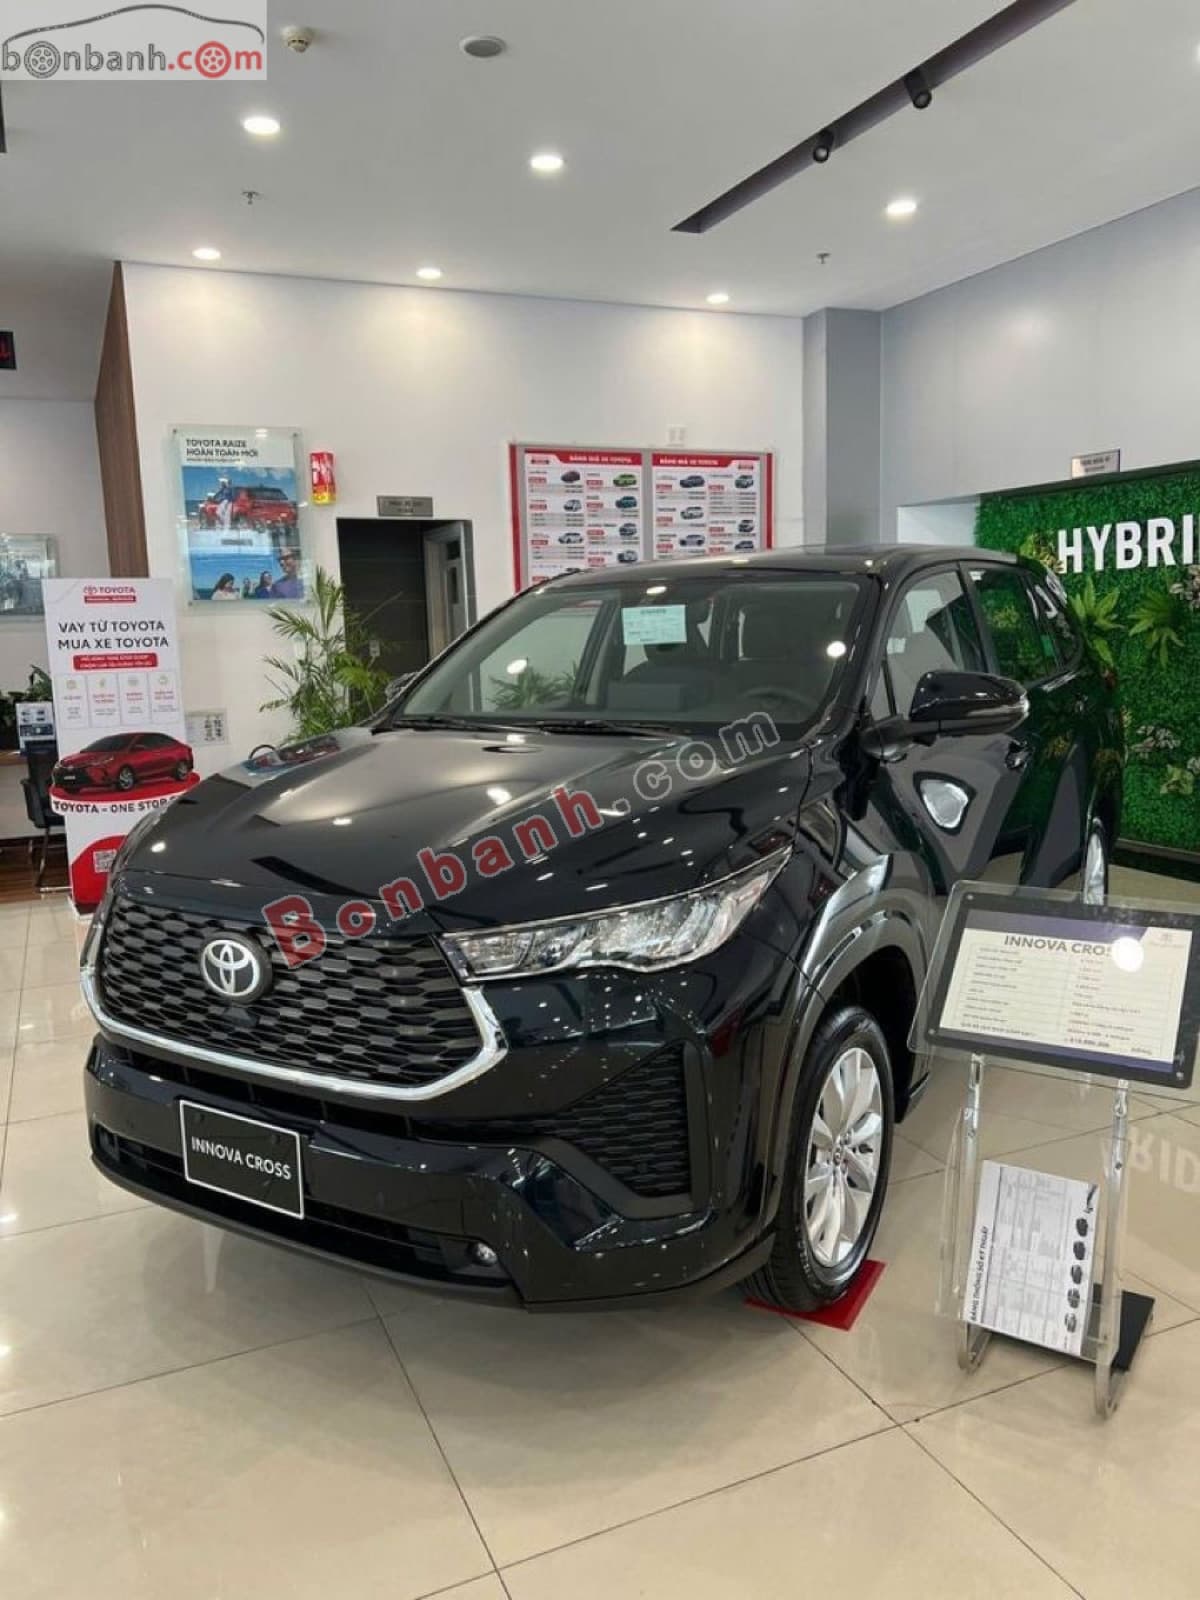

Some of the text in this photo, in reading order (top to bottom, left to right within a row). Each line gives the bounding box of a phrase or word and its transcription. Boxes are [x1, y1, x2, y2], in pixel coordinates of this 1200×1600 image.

[186, 439, 221, 448] TOYOTA
[1057, 513, 1200, 574] HYBRI
[99, 586, 136, 594] TOYOTA
[58, 622, 86, 633] VAY
[111, 620, 165, 633] TOYOTA
[58, 637, 169, 650] MUA XE TOYOTA
[53, 801, 100, 814] TOYOTA
[111, 803, 136, 813] ONE
[138, 798, 168, 812] STOP
[1003, 934, 1114, 958] INNOVA CRO
[191, 1135, 292, 1181] INNOVA CROSS
